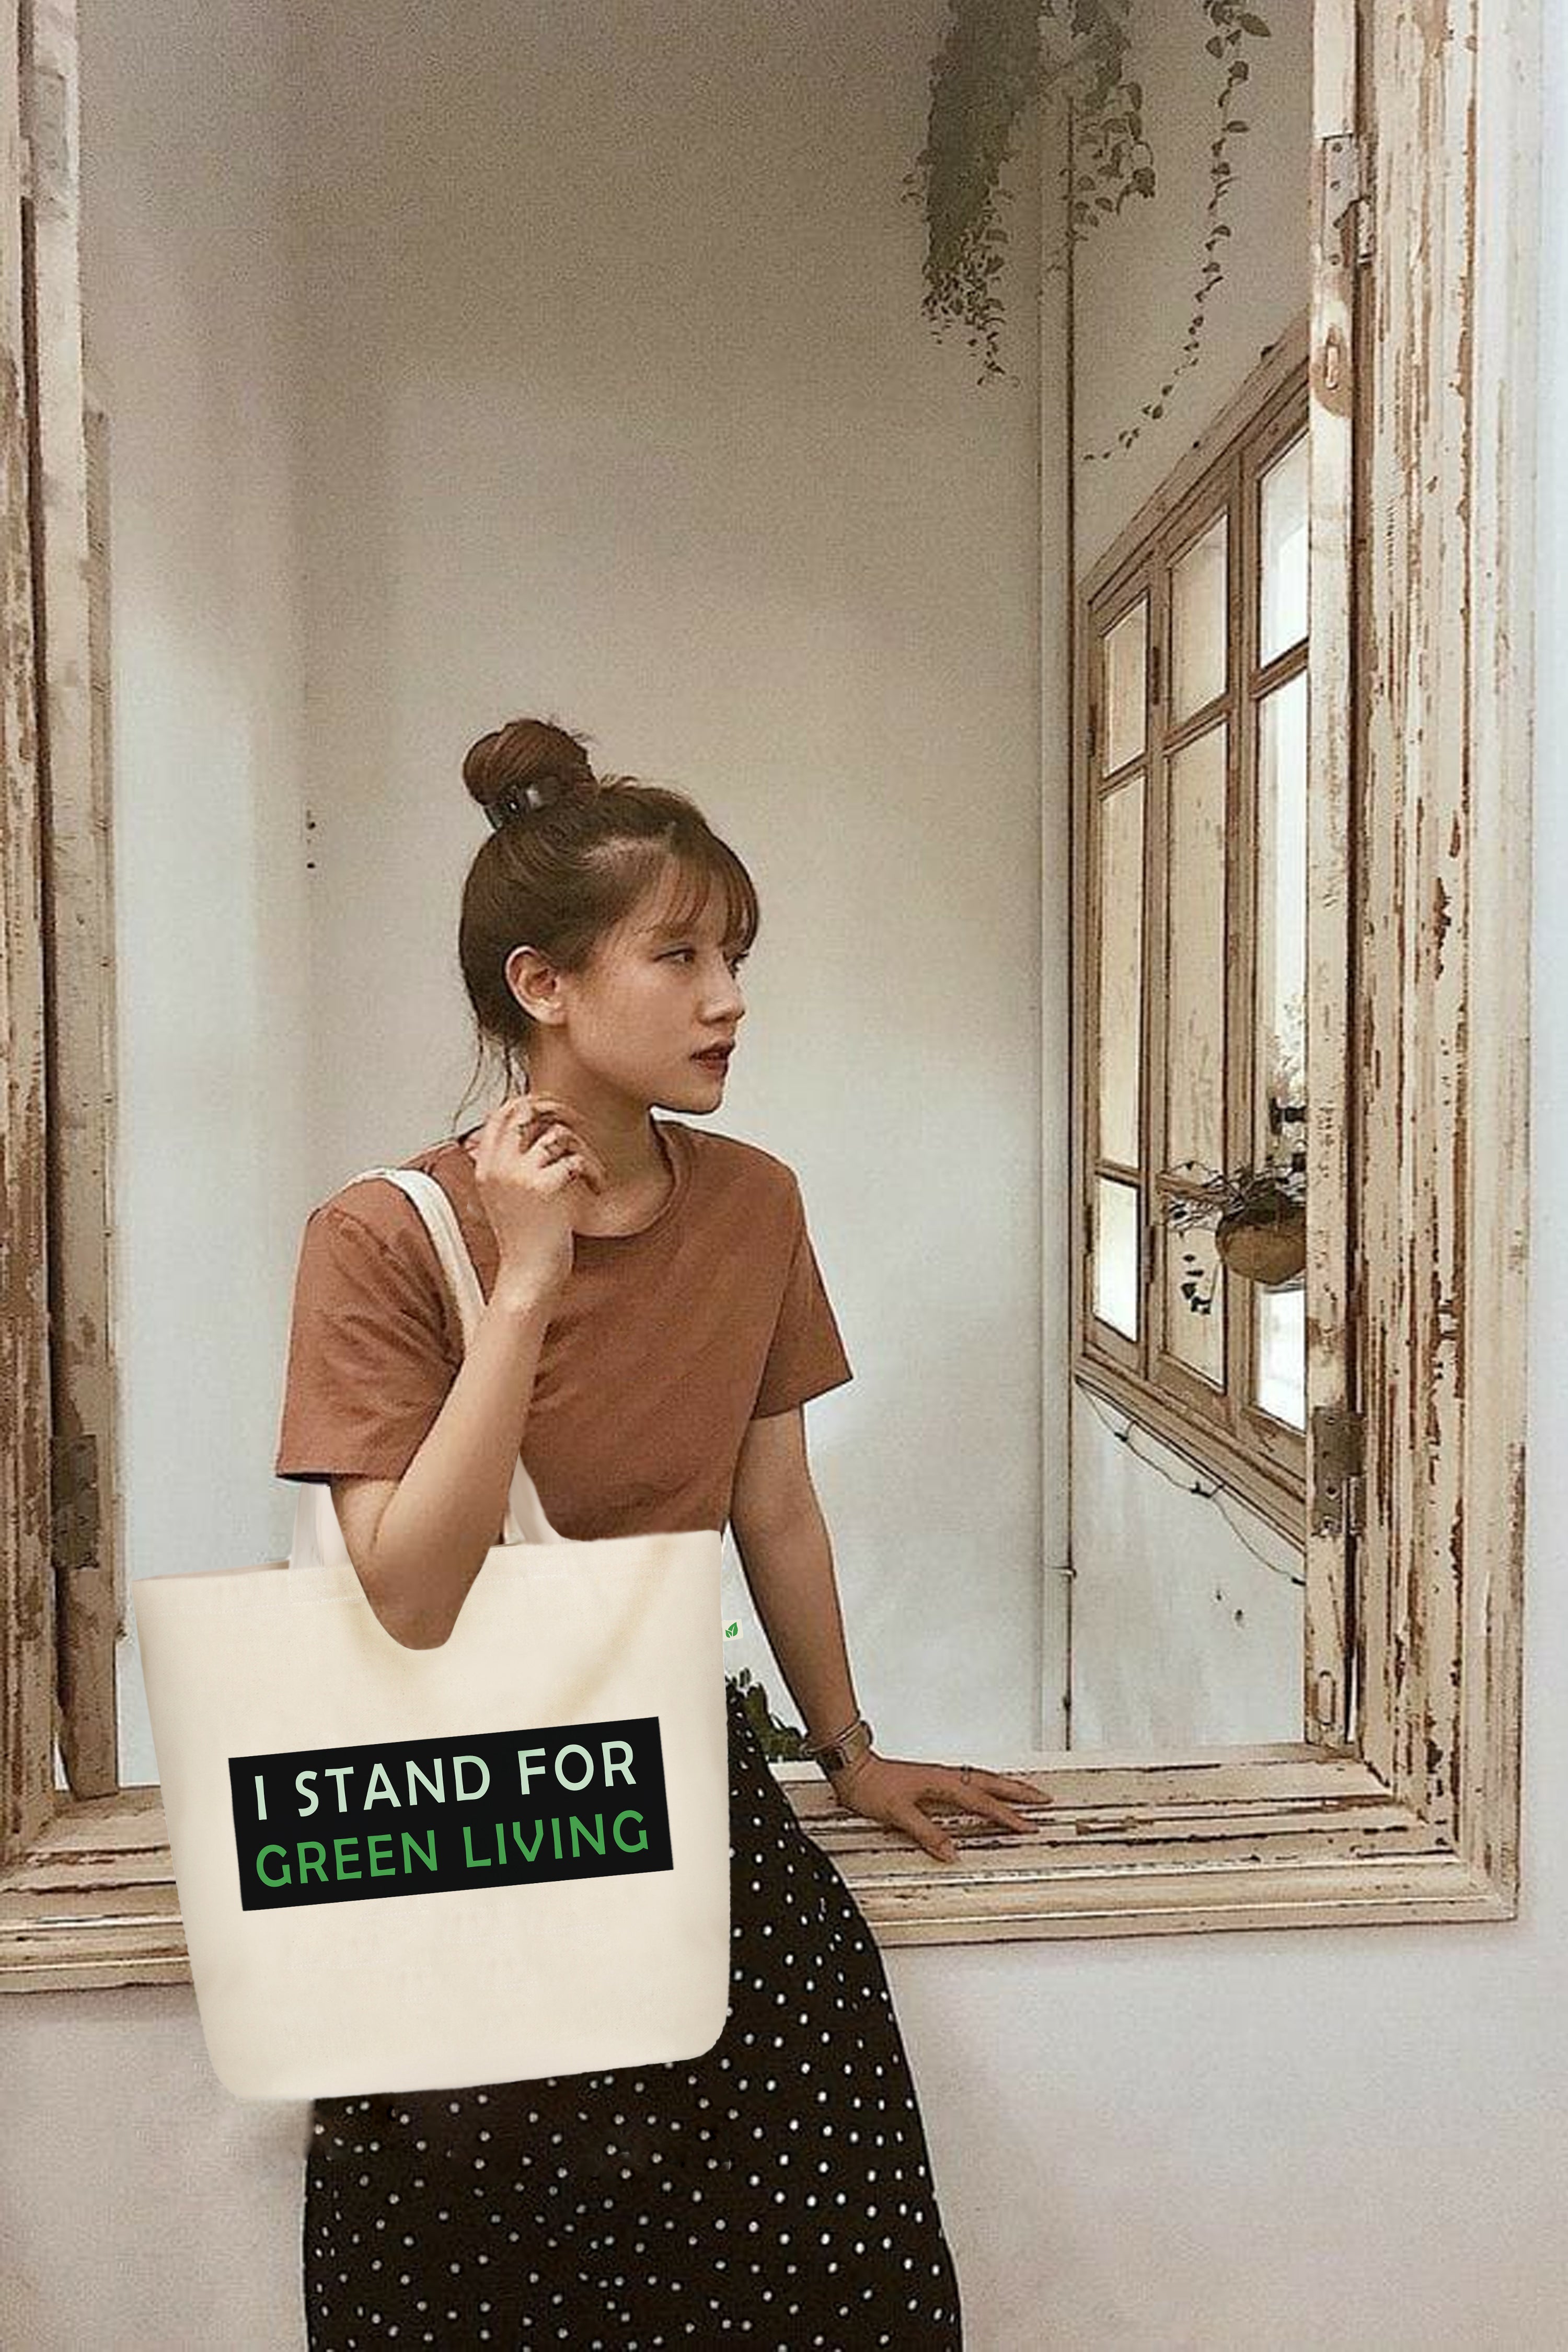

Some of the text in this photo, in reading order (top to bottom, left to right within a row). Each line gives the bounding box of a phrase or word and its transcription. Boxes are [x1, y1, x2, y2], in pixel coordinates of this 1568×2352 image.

[255, 1740, 637, 1820] I STAND FOR
[256, 1810, 649, 1887] GREEN LIVING
